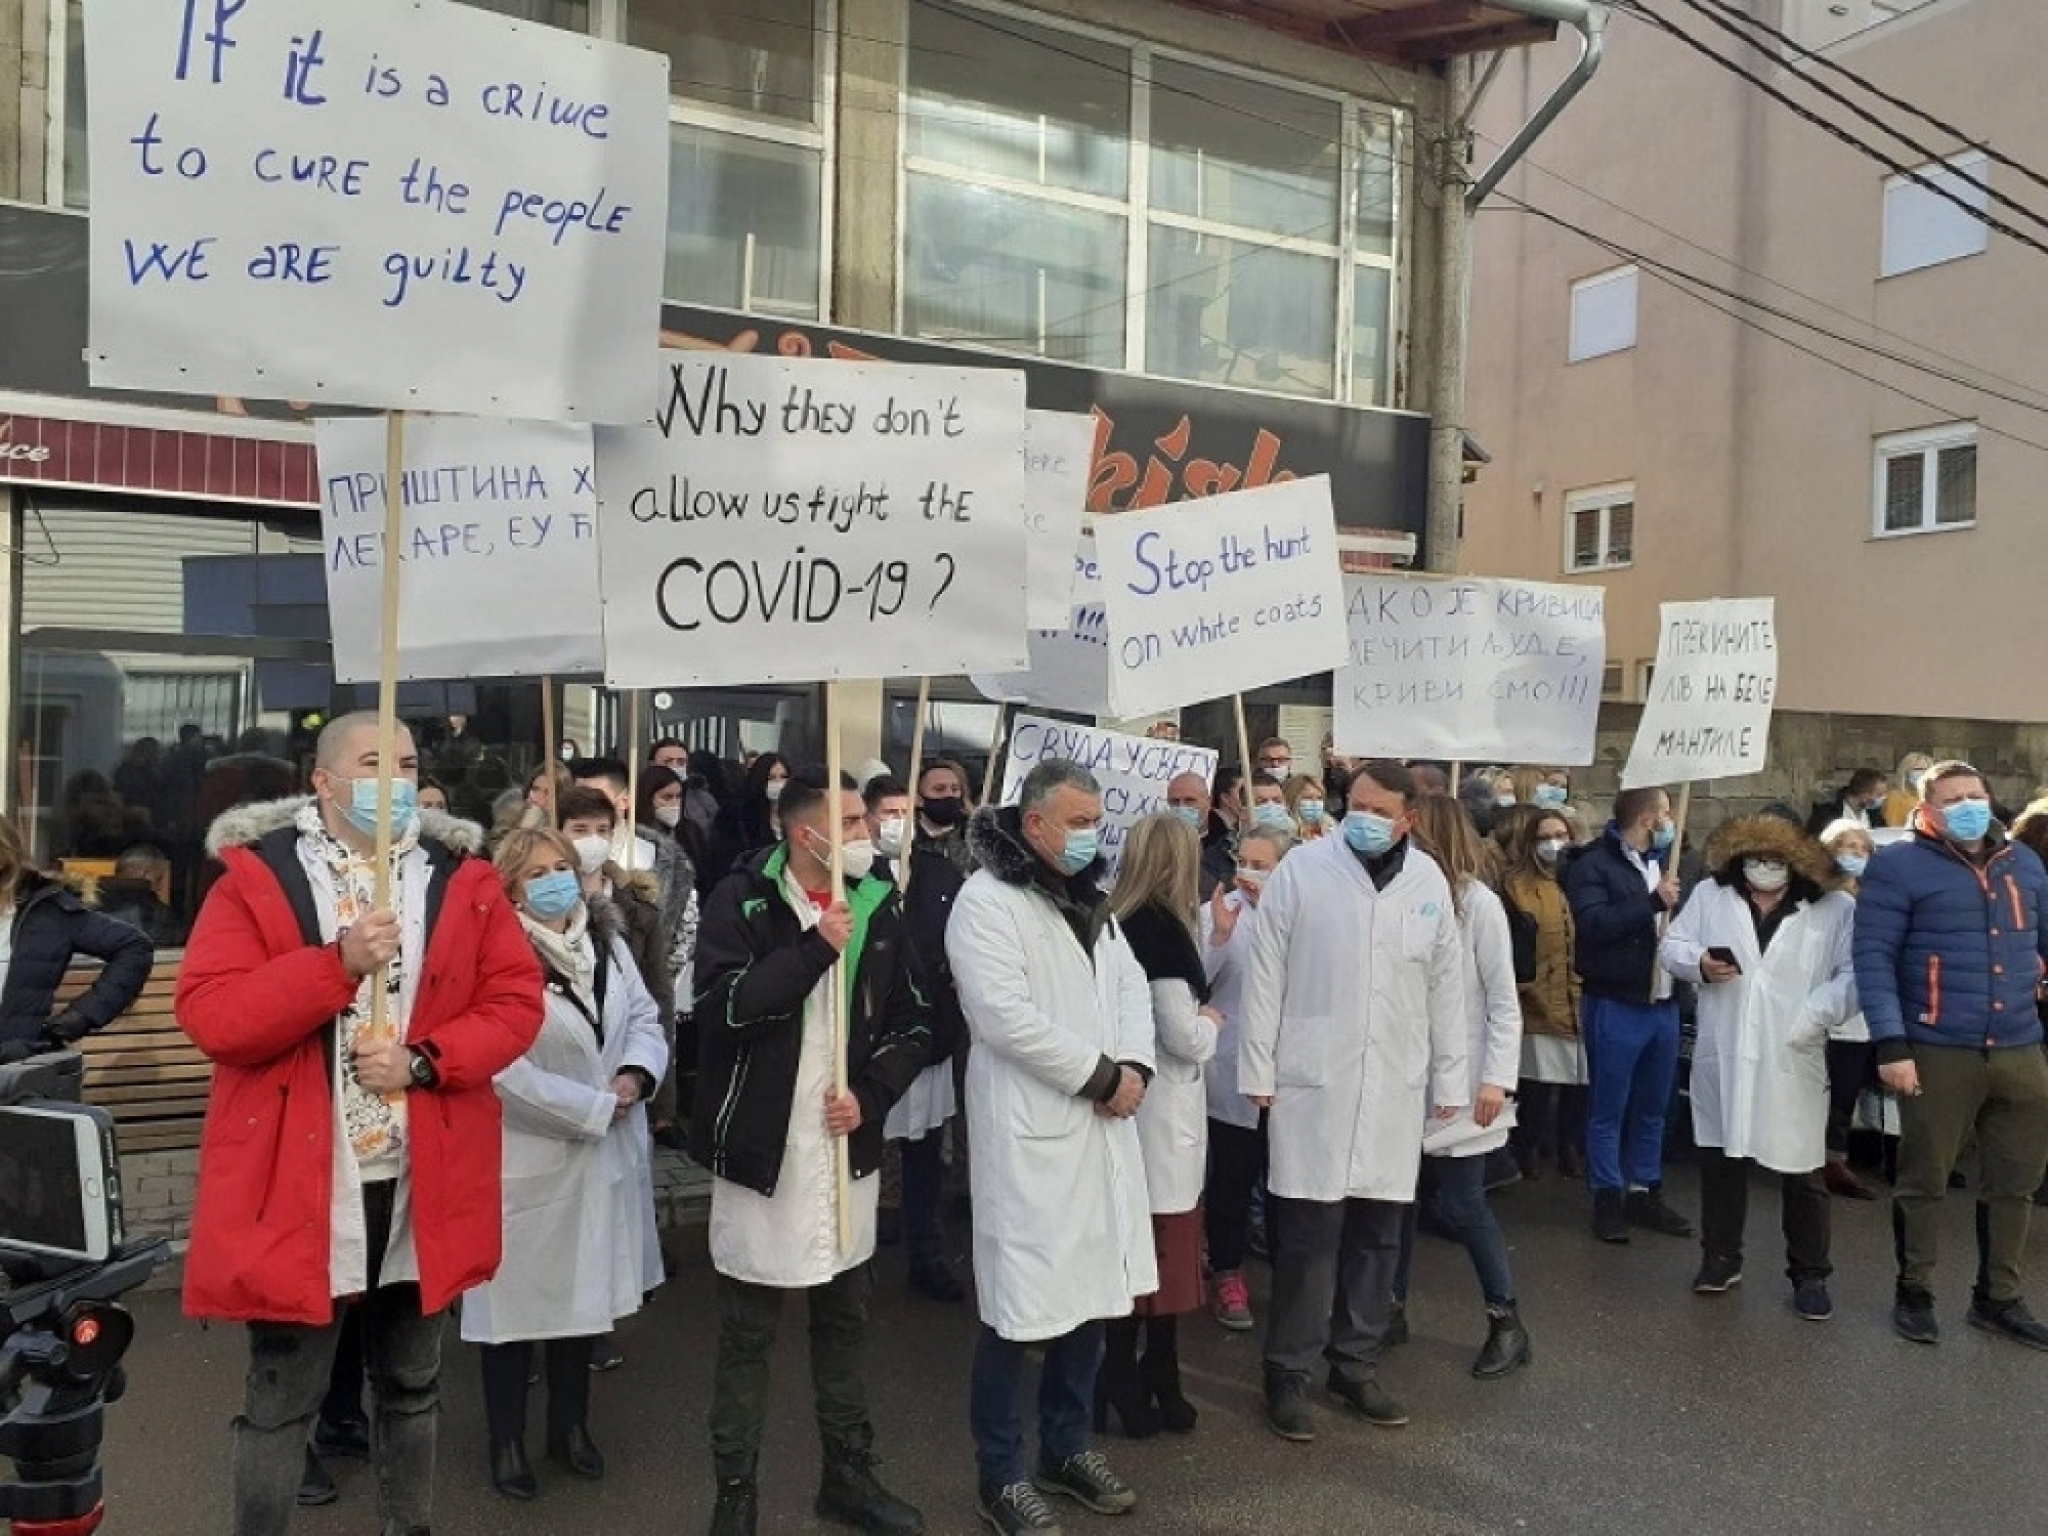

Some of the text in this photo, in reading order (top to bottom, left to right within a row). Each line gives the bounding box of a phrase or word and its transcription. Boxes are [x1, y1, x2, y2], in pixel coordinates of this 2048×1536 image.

[283, 30, 327, 104] it
[364, 53, 402, 97] is
[425, 73, 450, 106] a
[130, 112, 208, 178] to
[400, 157, 470, 214] the
[123, 236, 218, 286] WE
[656, 363, 767, 438] Why
[873, 396, 966, 438] don't
[630, 474, 749, 523] allow
[763, 491, 801, 524] us
[808, 481, 890, 533] fight
[331, 522, 495, 572] ЛЕАРЕ,
[508, 514, 552, 548] ЕУ
[1127, 524, 1313, 596] Stop the hunt
[1171, 611, 1241, 649] white
[1254, 593, 1323, 628] coats
[1353, 680, 1464, 709] КРИВИ
[1653, 726, 1752, 758] МАНТИЛЕ
